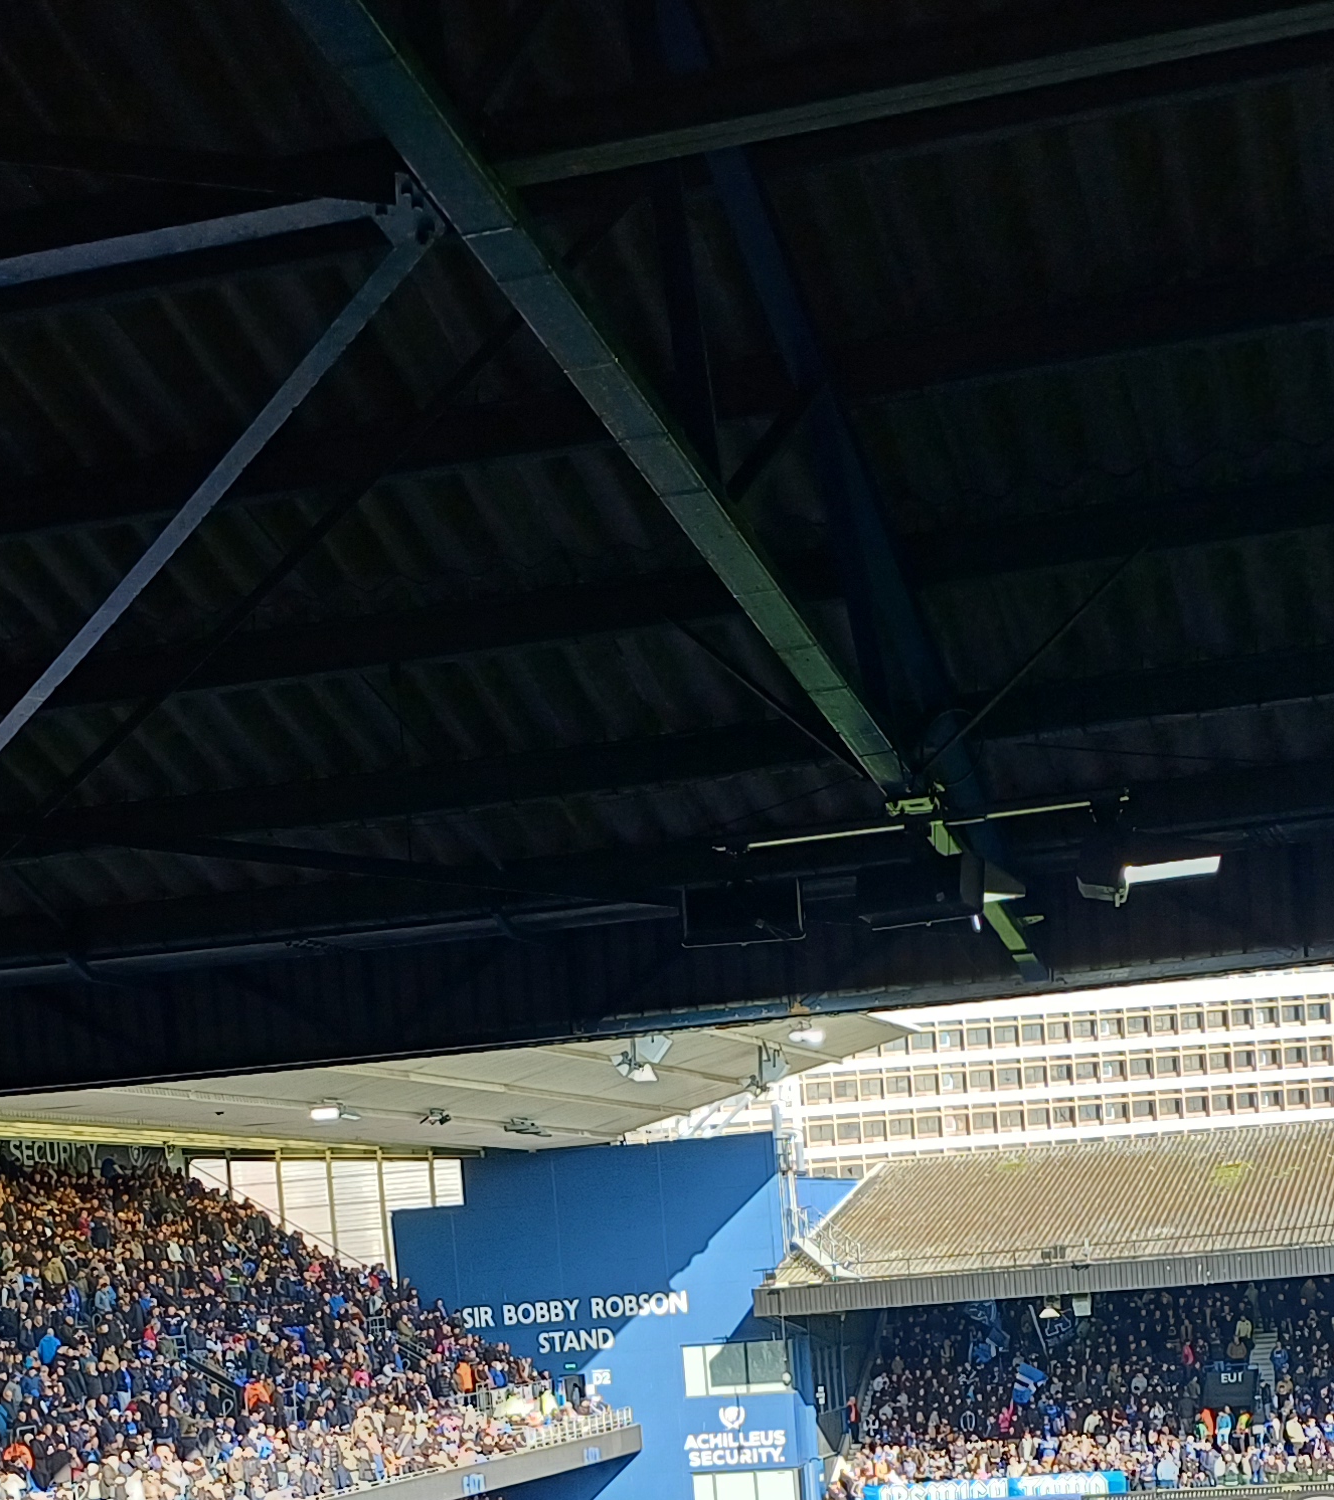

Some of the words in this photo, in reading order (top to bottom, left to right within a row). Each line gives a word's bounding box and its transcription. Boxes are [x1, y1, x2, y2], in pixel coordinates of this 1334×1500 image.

[462, 1306, 495, 1329] SIR
[502, 1299, 581, 1326] BOBBY
[591, 1289, 689, 1319] ROBSON
[537, 1327, 615, 1354] STAND
[592, 1373, 611, 1385] D2
[684, 1430, 786, 1451] ACHILLEUS
[688, 1446, 786, 1467] SECURITY.
